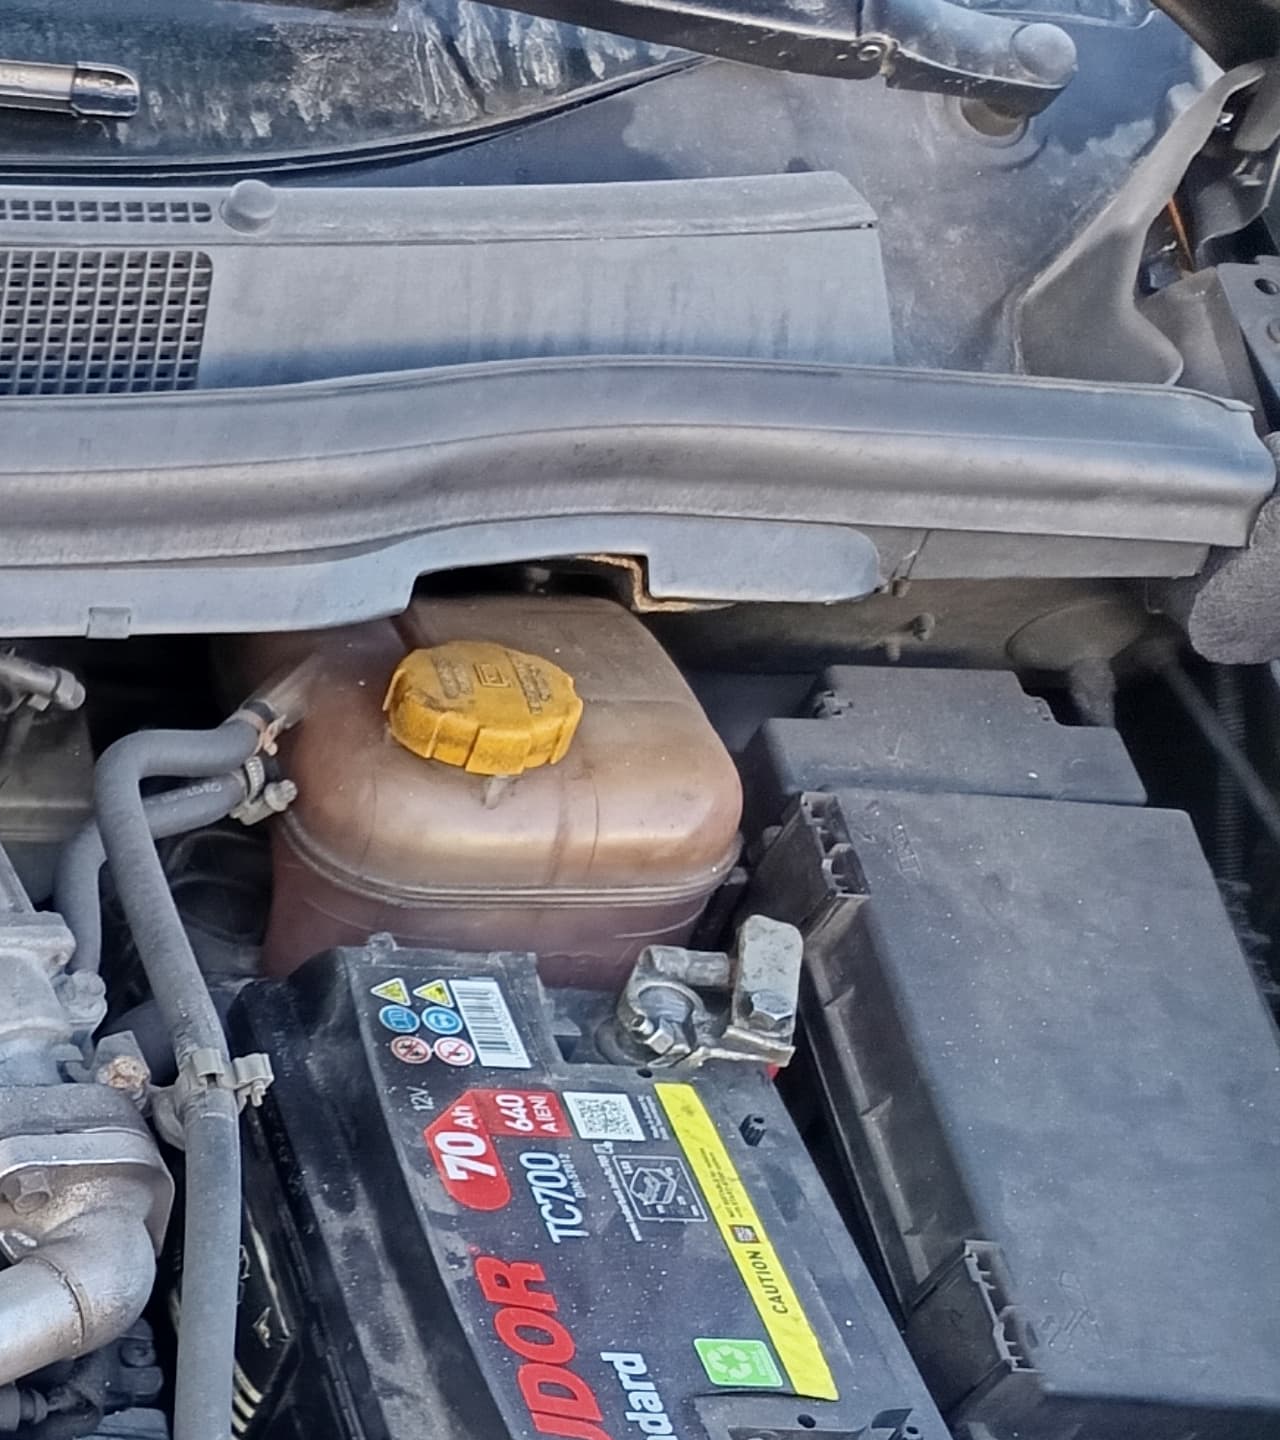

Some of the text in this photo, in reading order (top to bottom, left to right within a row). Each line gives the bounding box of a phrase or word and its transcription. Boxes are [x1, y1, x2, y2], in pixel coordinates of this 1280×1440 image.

[407, 1087, 434, 1111] 12V
[495, 1093, 534, 1132] 640
[434, 1106, 497, 1180] 70 Ah
[541, 1123, 560, 1133] A
[519, 1151, 590, 1244] TC700
[746, 1250, 789, 1315] CAUTION
